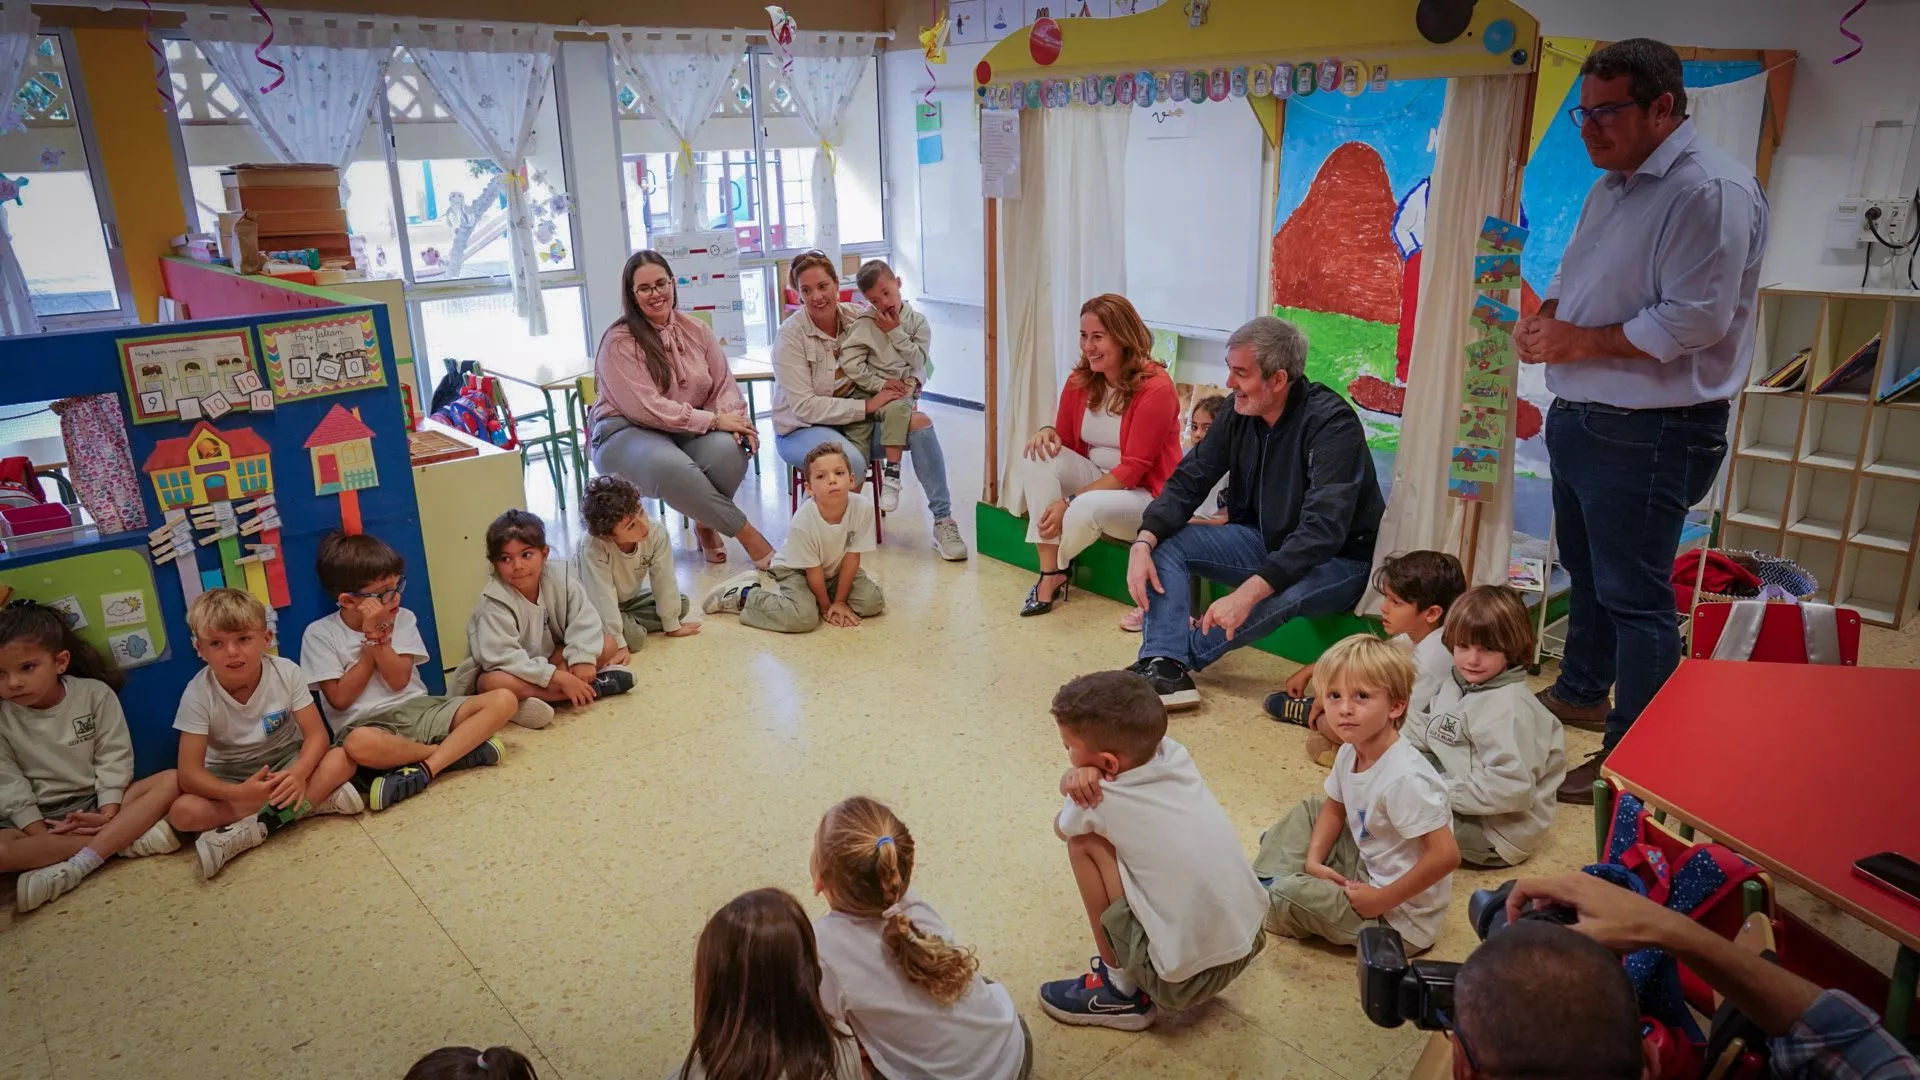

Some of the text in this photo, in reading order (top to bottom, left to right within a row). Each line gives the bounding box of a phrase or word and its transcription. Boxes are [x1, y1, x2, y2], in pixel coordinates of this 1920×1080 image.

[295, 328, 344, 343] Hoy faltan
[238, 376, 258, 390] 10
[147, 396, 158, 409] 9
[206, 397, 226, 414] 10
[254, 394, 271, 408] 10
